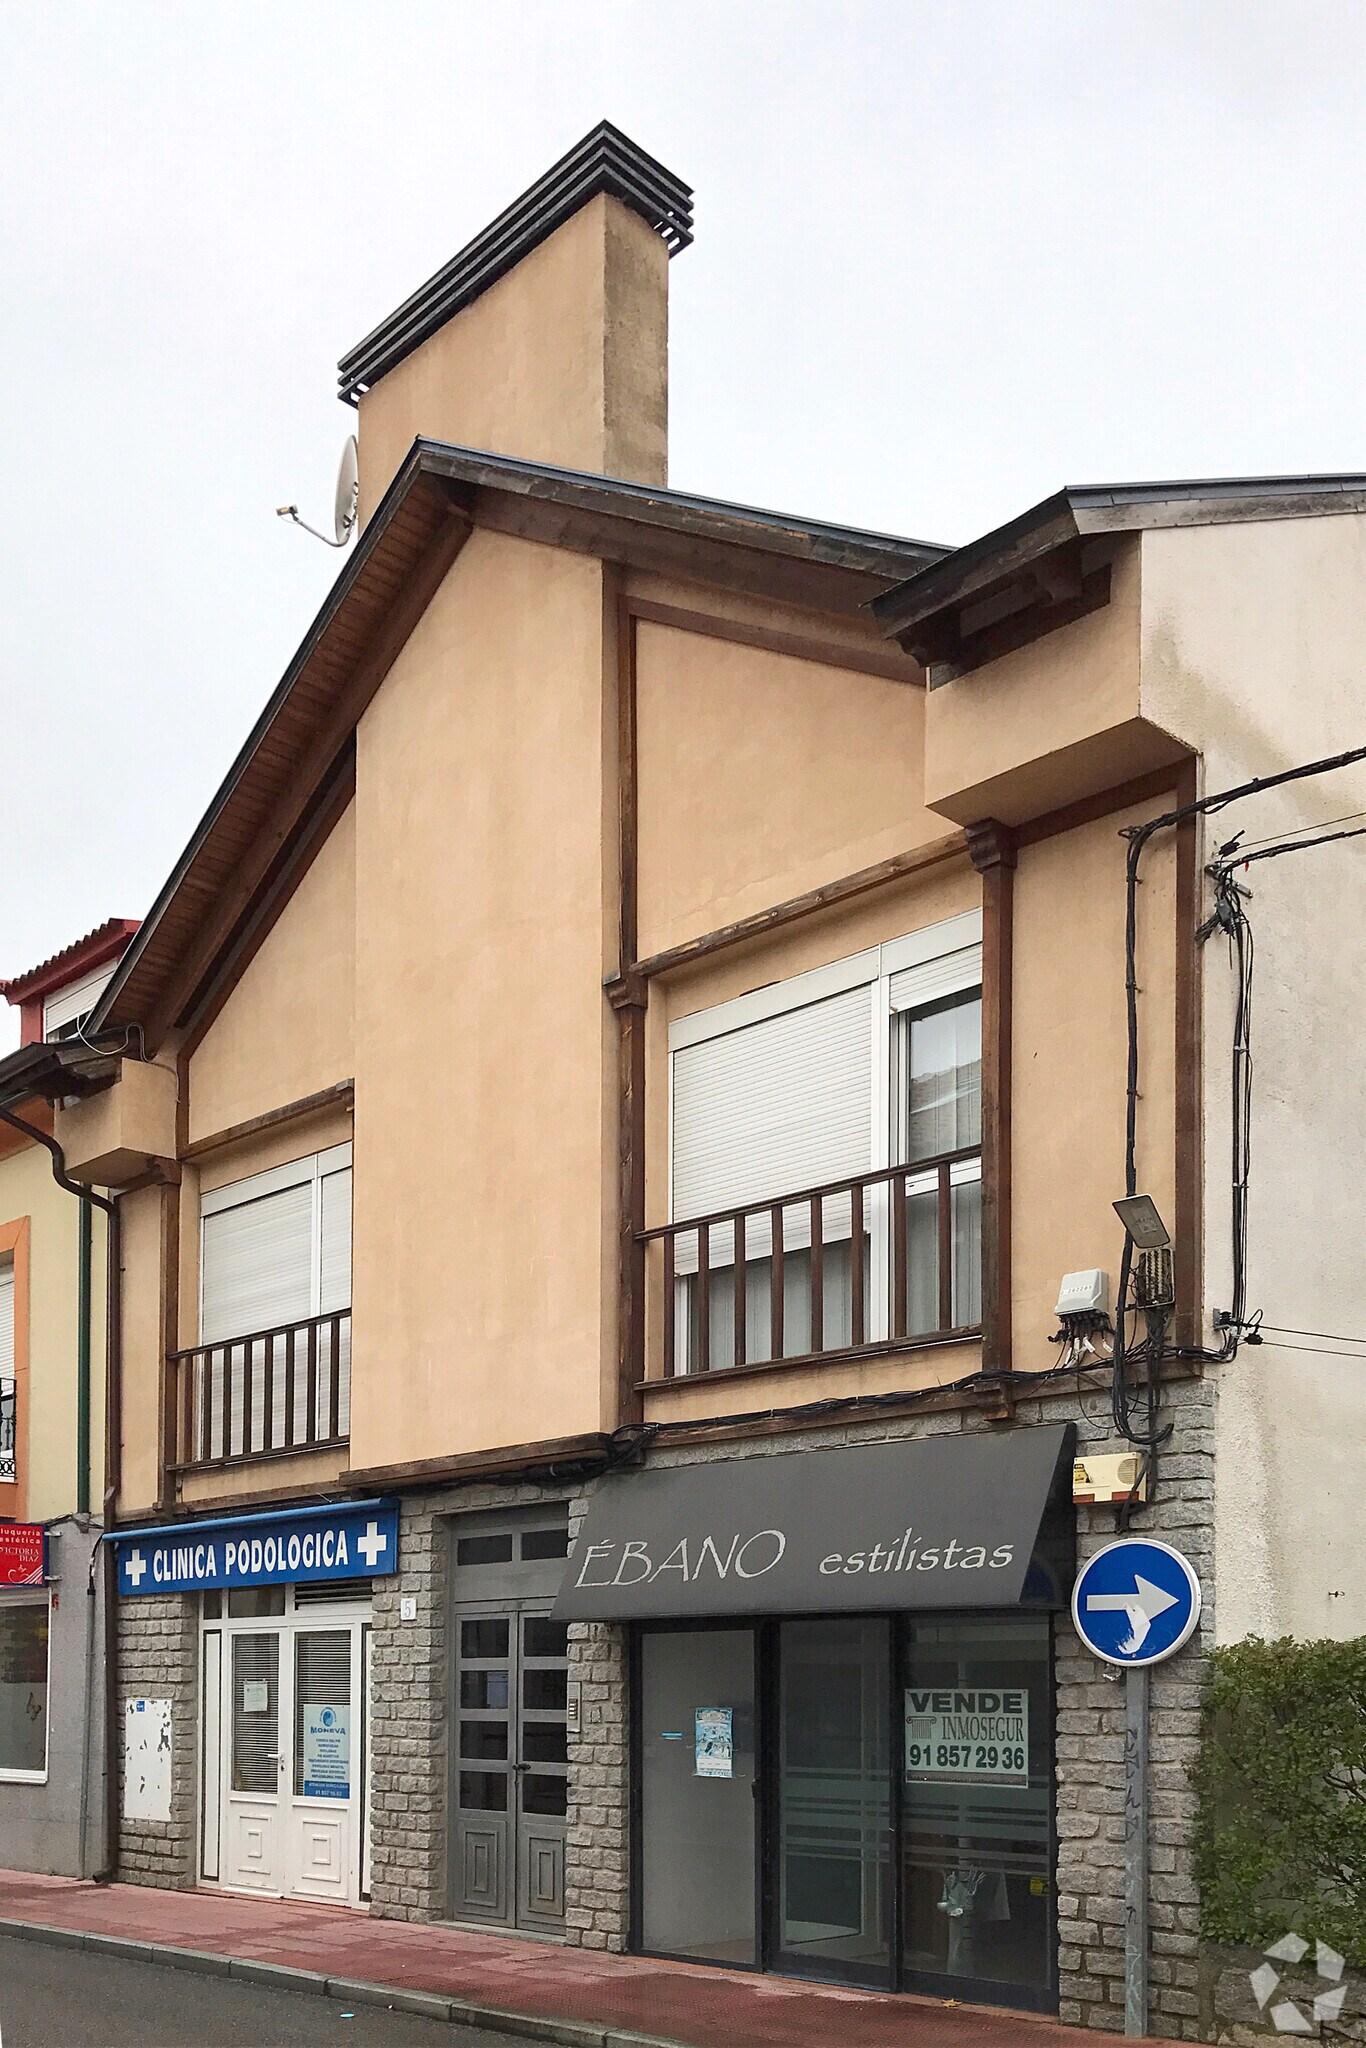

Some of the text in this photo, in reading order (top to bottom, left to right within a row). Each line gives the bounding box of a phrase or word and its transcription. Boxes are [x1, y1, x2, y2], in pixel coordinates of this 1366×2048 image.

[153, 1530, 349, 1583] CLINICA PODOLOGICA
[574, 1527, 1014, 1588] ÉBANO estilistas
[404, 1600, 411, 1618] 5
[907, 1692, 1023, 1714] VENDE
[310, 1726, 346, 1735] MONEVA
[942, 1716, 1025, 1742] INMOSEGUR
[909, 1744, 1025, 1770] 91 857 29 36
